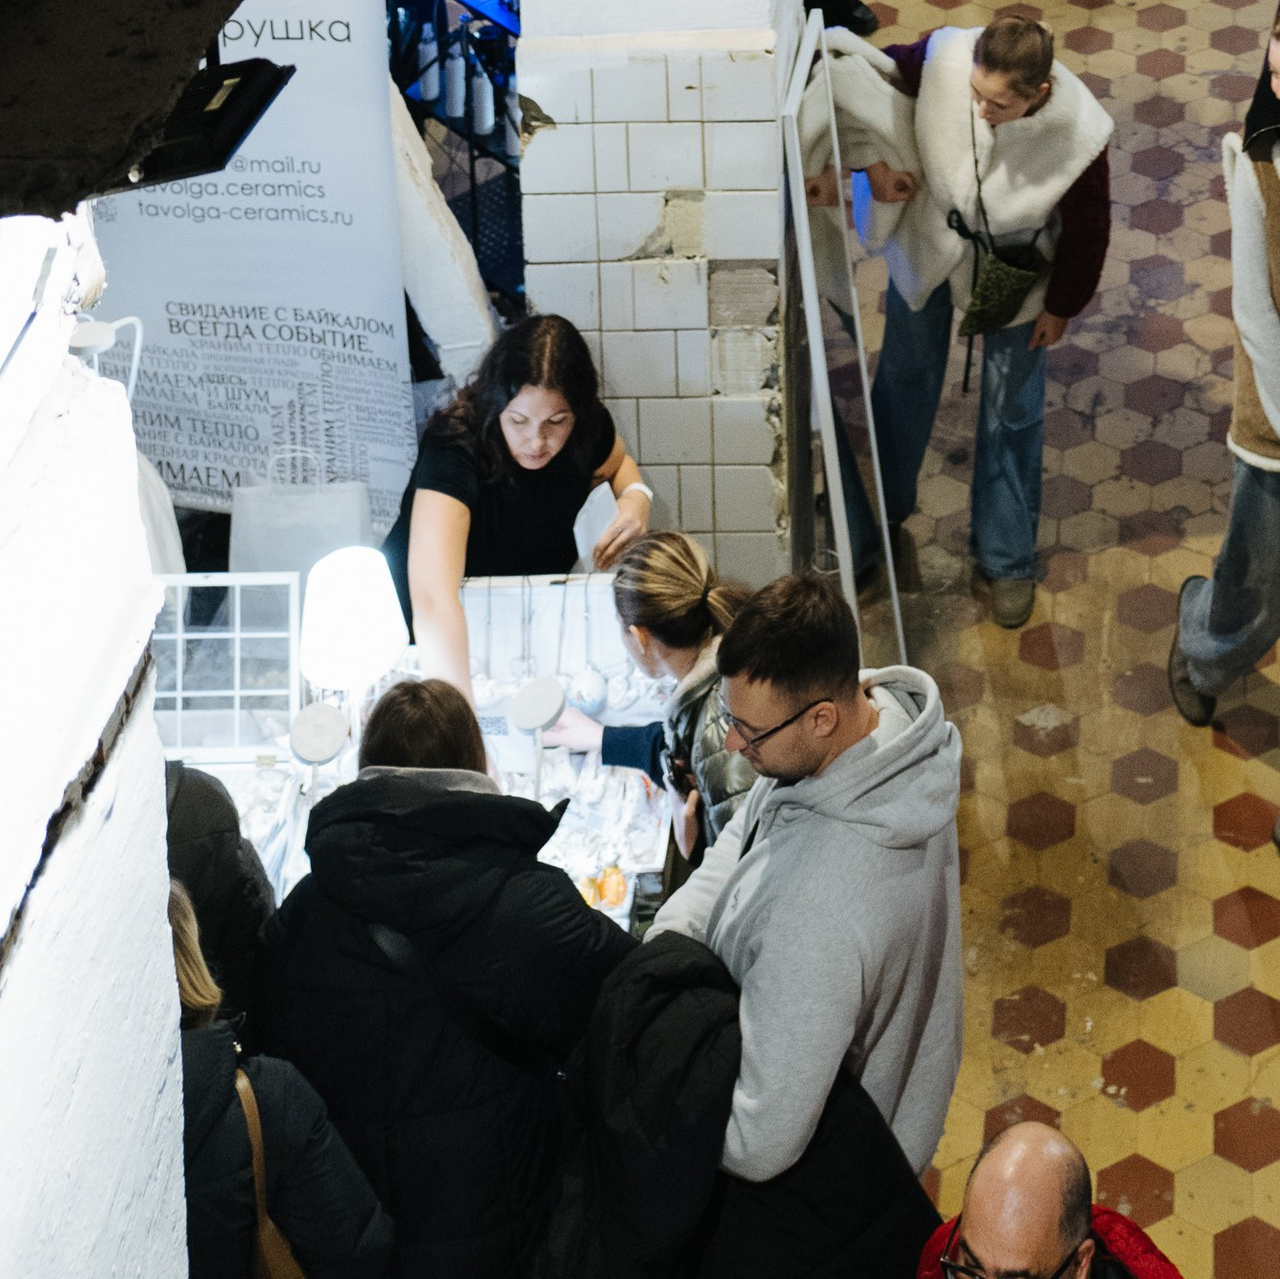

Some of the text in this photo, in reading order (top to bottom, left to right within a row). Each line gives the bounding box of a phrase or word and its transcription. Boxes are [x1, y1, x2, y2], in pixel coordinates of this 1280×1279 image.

[222, 19, 351, 47] рушка
[231, 155, 321, 175] @mail.ru
[140, 179, 326, 199] avolga.ceramics
[138, 201, 353, 226] tavolga-ceramics.ru
[165, 301, 394, 338] СВИДАНИЕ С БАЙКАЛОМ
[169, 318, 252, 341] ВСЕГДА
[309, 347, 398, 373] ОБНИМАЕМ
[226, 386, 270, 403] ШУМ
[186, 417, 260, 441] ТЕПЛО
